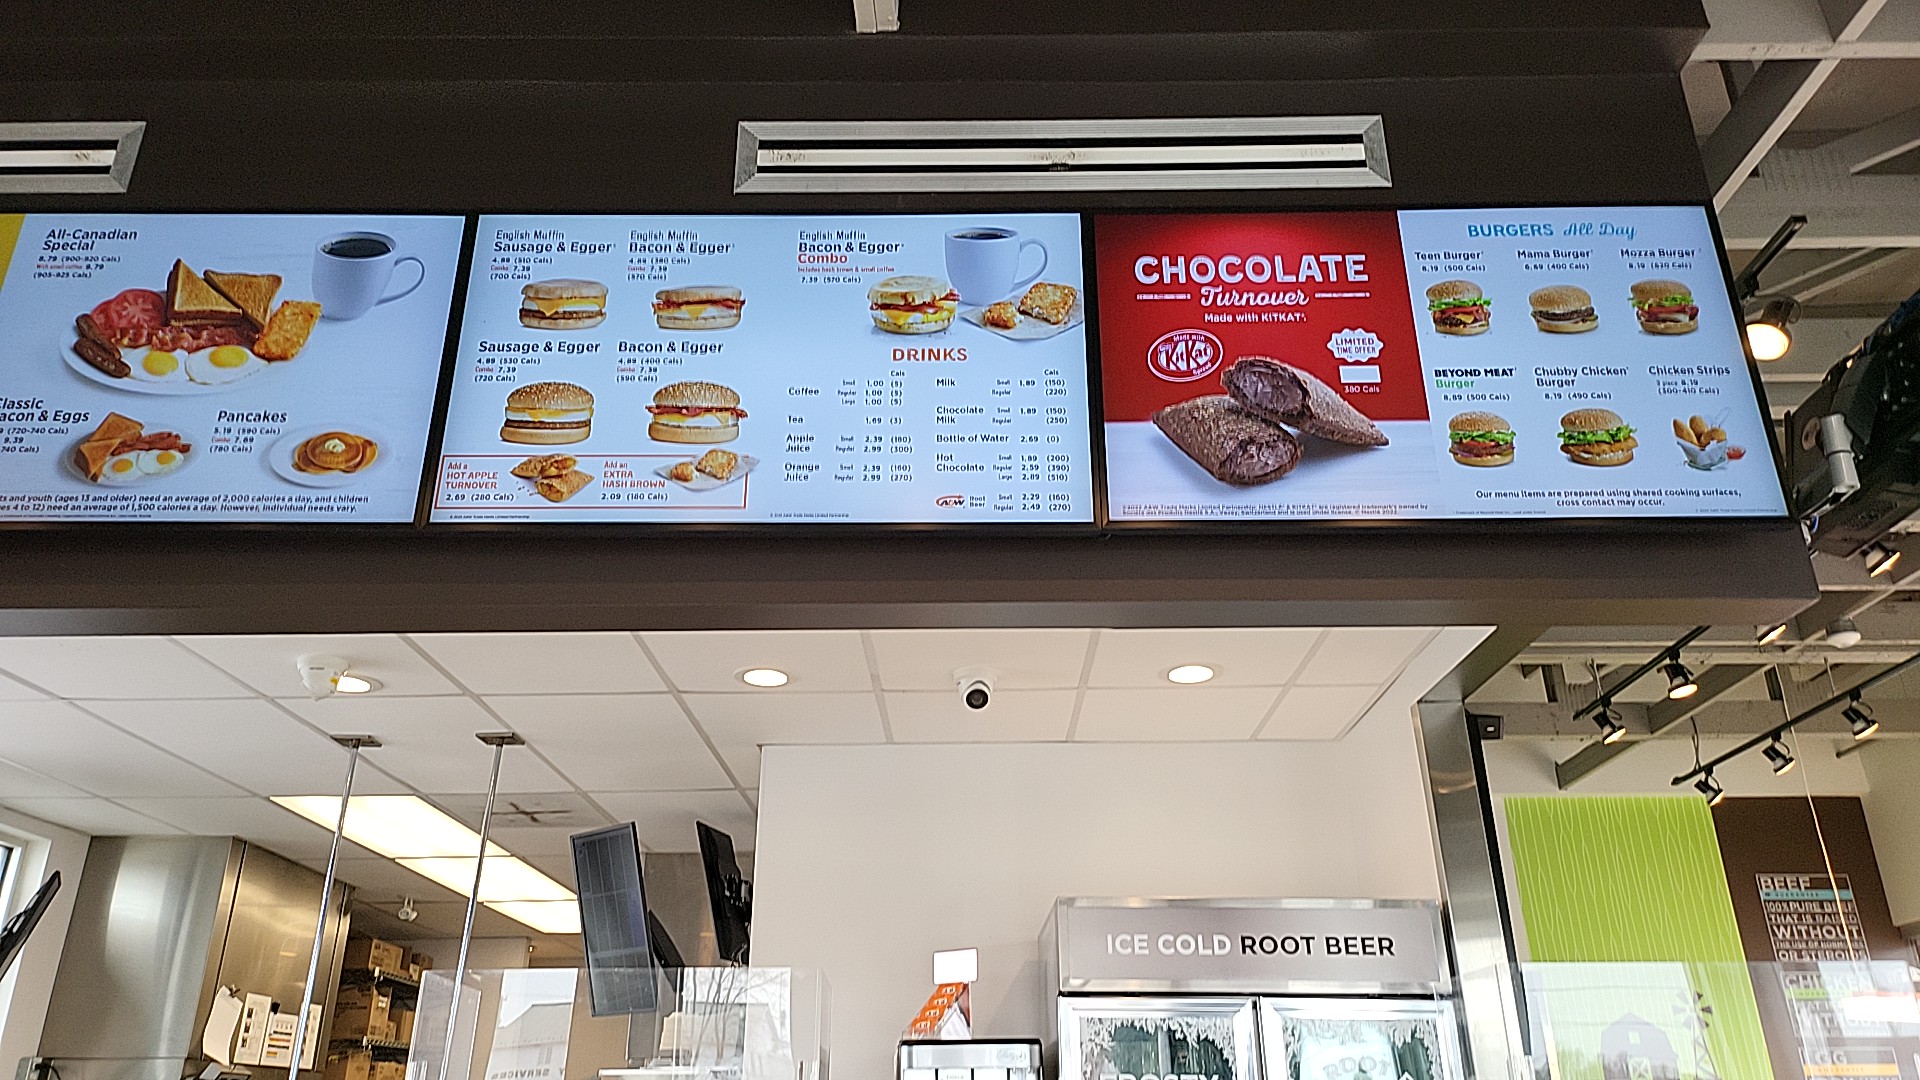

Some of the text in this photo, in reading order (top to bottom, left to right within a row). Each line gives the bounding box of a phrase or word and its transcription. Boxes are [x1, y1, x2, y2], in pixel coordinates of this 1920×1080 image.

[46, 228, 138, 240] All-Canadian
[496, 229, 565, 241] English Muffin
[630, 230, 698, 241] English Muffin
[799, 230, 866, 241] English Muffin
[1467, 222, 1637, 240] BURGERS All Day
[42, 240, 95, 252] Special
[493, 241, 553, 254] Sausage
[556, 241, 566, 253] &
[629, 242, 672, 253] Bacon
[675, 242, 685, 253] &
[798, 242, 842, 253] Bacon
[844, 242, 855, 253] &
[1414, 251, 1441, 260] Teen
[1517, 250, 1550, 259] Mama
[1619, 248, 1656, 258] Mozza
[797, 253, 848, 264] Combo
[1134, 254, 1369, 285] CHOCOLATE
[1200, 284, 1310, 307] Turnover
[1204, 312, 1233, 323] Made
[1235, 312, 1258, 322] with
[1335, 337, 1375, 346] LIMITED
[478, 341, 601, 354] Sausage & Egger
[618, 341, 663, 353] Bacon
[666, 341, 676, 353] &
[1336, 346, 1376, 354] TIME OFFER
[892, 348, 968, 361] DRINKS
[1434, 368, 1481, 377] BEYOND
[1534, 366, 1578, 377] Chubby
[1648, 365, 1731, 377] Chicken Strips
[936, 378, 956, 387] Milk
[1044, 379, 1066, 387] (150)
[1435, 379, 1475, 389] Burger
[1536, 378, 1576, 387] Burger
[788, 387, 820, 396] Coffee
[1045, 388, 1067, 396] (220)
[1362, 385, 1380, 393] Cals
[936, 406, 984, 414] Chocolate
[0, 410, 90, 424] acon & Eggs
[217, 410, 287, 423] Pancakes
[788, 415, 804, 424] Tea
[936, 415, 956, 424] Milk
[786, 433, 815, 443] Apple
[936, 434, 1009, 443] Bottle of Water
[936, 453, 953, 461] Hot
[447, 462, 461, 470] Add
[784, 462, 820, 472] Orange
[936, 463, 985, 472] Chocolate
[446, 471, 499, 480] HOT APPLE
[603, 470, 633, 478] EXTRA
[784, 473, 809, 481] Juice
[445, 481, 498, 489] TURNOVER
[602, 480, 666, 488] HASH BROWN
[445, 493, 466, 501] 2.69
[493, 493, 514, 502] Cals)
[1475, 490, 1492, 498] Our
[1521, 490, 1546, 498] items
[1563, 489, 1604, 498] prepared
[1606, 489, 1631, 498] using
[1632, 488, 1663, 497] shared
[1664, 488, 1700, 497] cooking
[1701, 488, 1742, 497] surfaces,
[8, 494, 26, 502] and
[27, 494, 53, 503] youth
[54, 494, 79, 503] (ages
[91, 494, 109, 502] and
[109, 494, 137, 503] older)
[138, 494, 161, 502] need
[174, 495, 210, 503] average
[211, 494, 222, 502] of
[222, 494, 250, 503] 2,000
[251, 494, 286, 502] calories
[314, 494, 331, 502] and
[333, 494, 369, 503] children
[1617, 499, 1635, 507] may
[1637, 498, 1665, 506] occur.
[20, 503, 30, 511] to
[46, 503, 69, 511] need
[82, 504, 118, 512] average
[119, 503, 130, 511] of
[131, 503, 155, 512] 1,500
[156, 503, 192, 511] calories
[220, 503, 260, 512] However,
[262, 503, 306, 511] individual
[1760, 876, 1810, 891] BEEF
[1765, 901, 1789, 912] 100%
[1769, 913, 1799, 924] THAT
[1815, 914, 1857, 923] RAISD
[1772, 924, 1859, 939] WITHOUT
[1105, 933, 1396, 957] ICE COLD ROOT BEER
